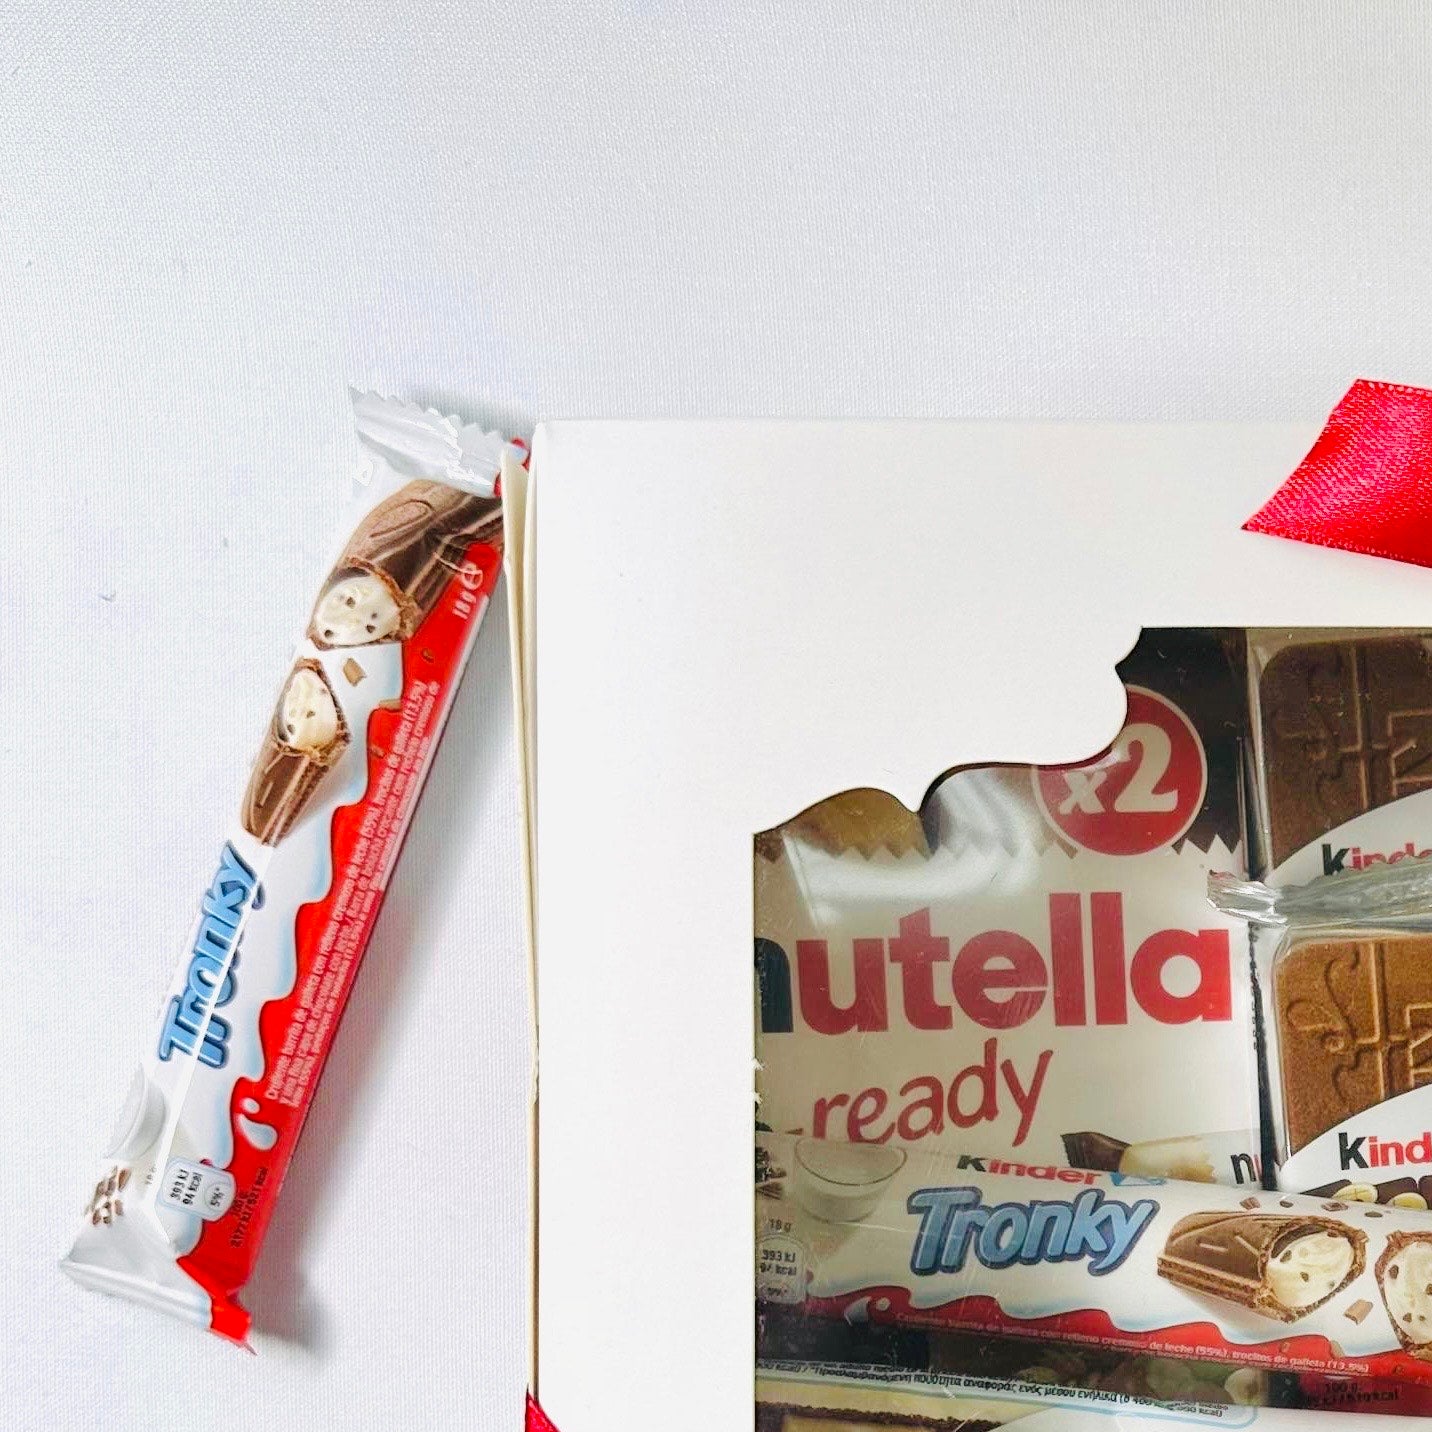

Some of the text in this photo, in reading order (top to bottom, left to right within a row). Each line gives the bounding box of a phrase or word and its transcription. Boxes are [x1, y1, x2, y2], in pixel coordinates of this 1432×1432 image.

[1059, 721, 1179, 815] x2
[159, 840, 264, 1068] Tronky
[811, 1037, 1055, 1147] ready
[908, 1186, 1160, 1277] Tronky
